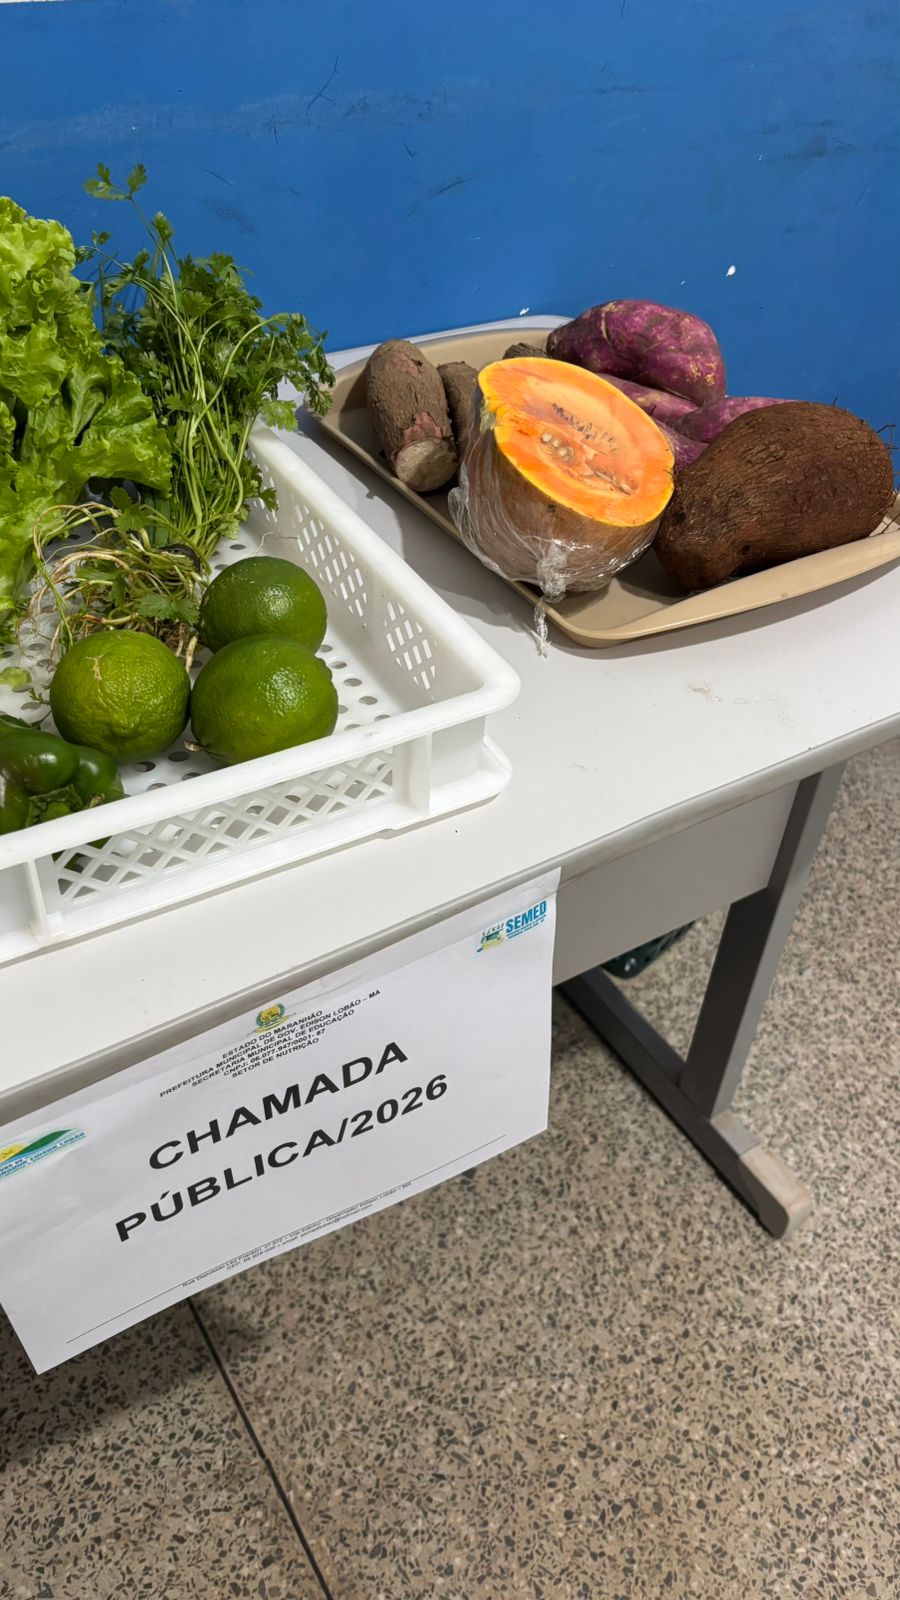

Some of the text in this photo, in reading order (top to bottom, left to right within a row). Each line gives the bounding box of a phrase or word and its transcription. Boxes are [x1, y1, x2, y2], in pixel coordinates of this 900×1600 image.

[506, 900, 547, 933] SEMED
[160, 1067, 214, 1097] PREFEITURA
[216, 1044, 262, 1068] MUNICIPAL
[264, 1036, 275, 1045] DE
[277, 1027, 298, 1039] GOV.
[300, 1013, 331, 1030] EDISON
[333, 999, 361, 1016] LOBÃO
[368, 989, 381, 999] MA
[192, 1009, 355, 1087] SECRETARIA MUNICIPAL DE EDUCAÇÃO
[222, 1010, 323, 1058] ESTADO DO MARANHÃO
[232, 1037, 319, 1078] SETOR DE NUTRIÇÃO
[223, 1062, 248, 1076] CNPJ:
[149, 1041, 409, 1170] CHAMADA
[115, 1074, 448, 1242] PÚBLICA/2026
